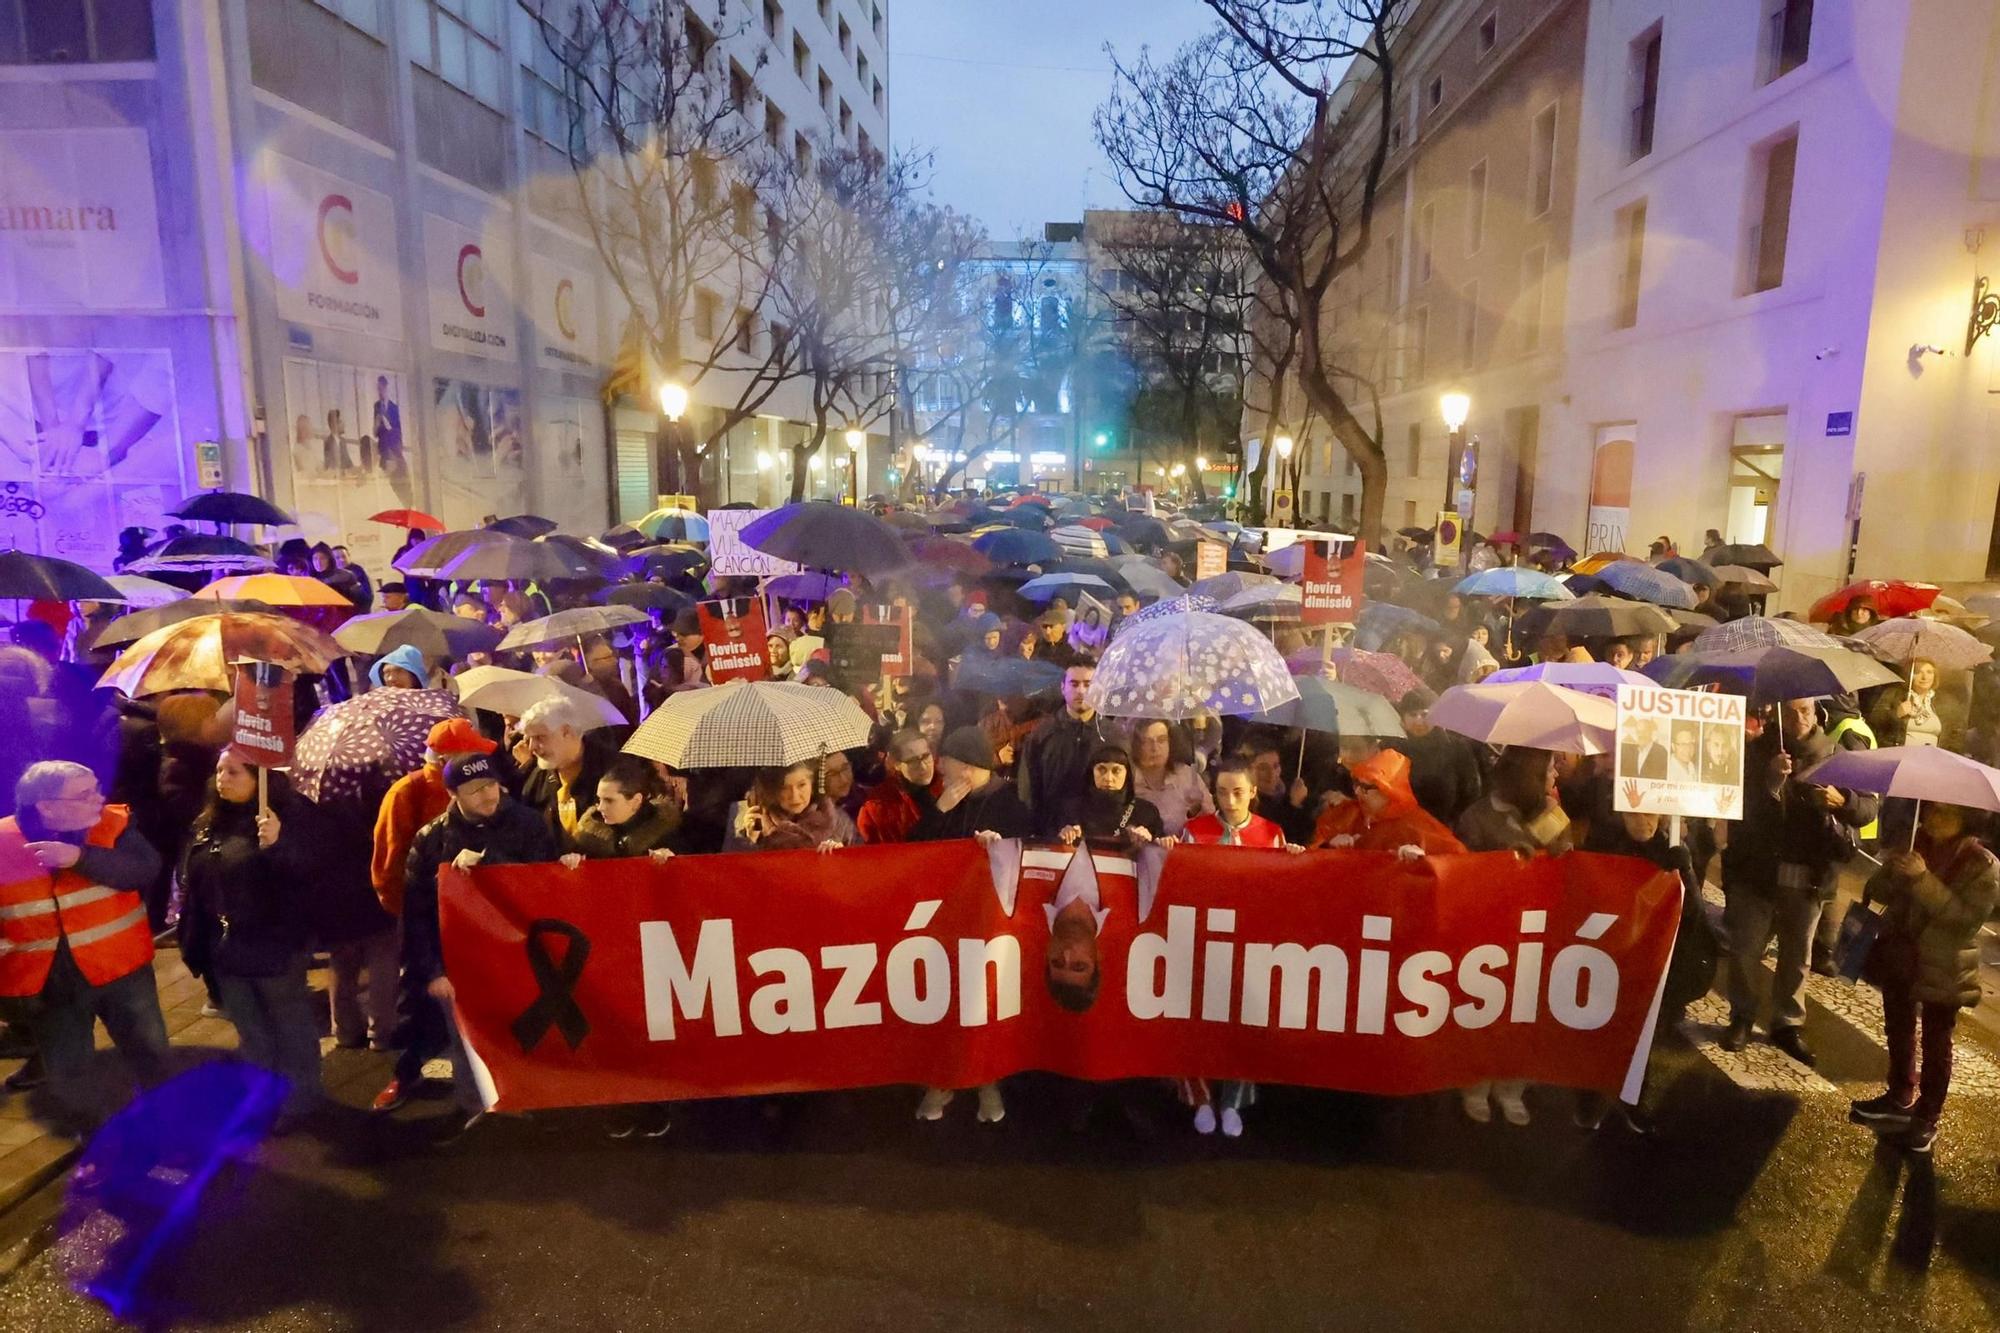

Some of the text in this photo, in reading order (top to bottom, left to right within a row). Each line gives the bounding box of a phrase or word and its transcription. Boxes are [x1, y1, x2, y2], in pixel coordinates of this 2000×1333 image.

[713, 555, 770, 574] CANCIÓN
[1305, 581, 1341, 594] Rovira
[1305, 595, 1352, 609] dimissió
[708, 641, 747, 657] Rovira
[881, 652, 903, 663] issió
[712, 652, 761, 671] dimissió
[1622, 689, 1741, 721] JUSTICIA
[237, 709, 272, 732] Rovira
[235, 728, 284, 753] dimissió
[462, 759, 489, 776] SWAT
[640, 899, 1620, 1043] Mazón dimissió
